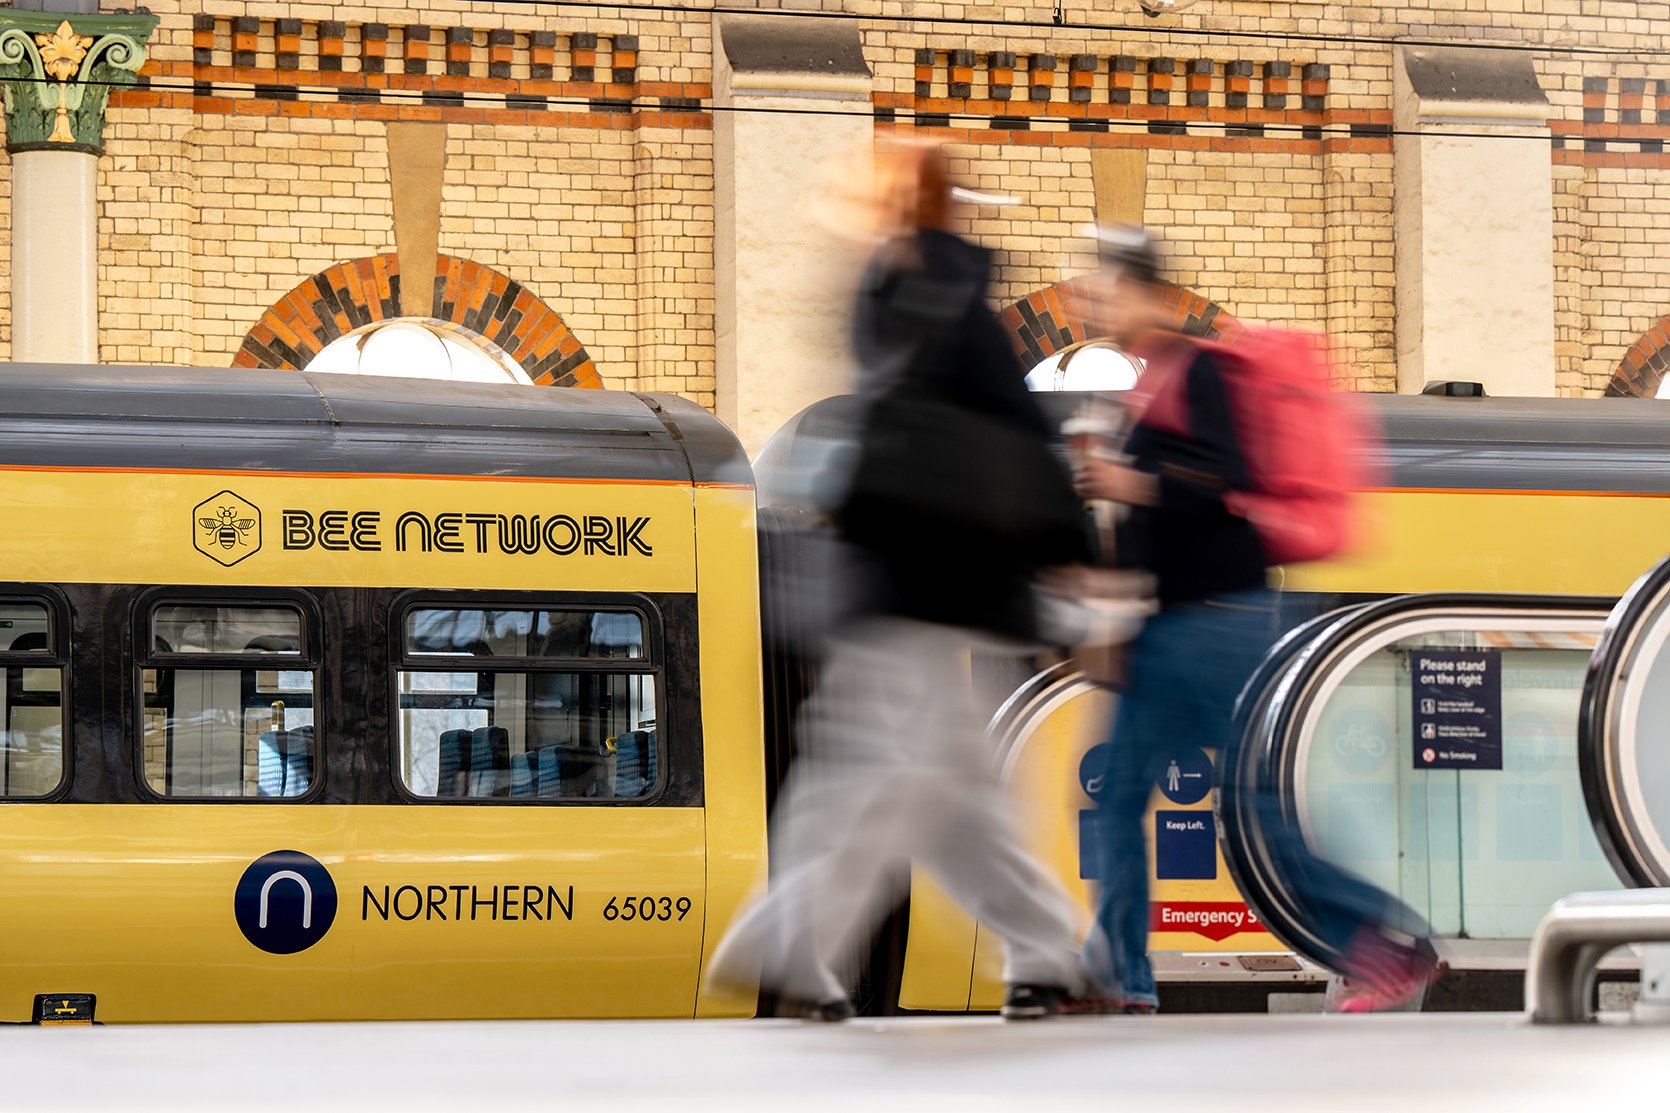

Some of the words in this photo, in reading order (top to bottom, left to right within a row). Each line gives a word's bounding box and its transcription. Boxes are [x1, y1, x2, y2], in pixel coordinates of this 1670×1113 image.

[282, 509, 382, 552] BEE
[395, 511, 653, 557] NETWORK
[1420, 659, 1454, 671] Please
[1456, 660, 1486, 672] stand
[1421, 675, 1435, 684] on
[1437, 673, 1455, 685] the
[1457, 673, 1482, 688] right
[1439, 751, 1449, 760] No
[1449, 751, 1477, 761] Smoking
[1166, 820, 1187, 831] Keep
[1187, 820, 1206, 830] Left.
[361, 885, 574, 921] NORTHERN
[602, 895, 692, 922] 65039
[1162, 908, 1244, 927] Emergency
